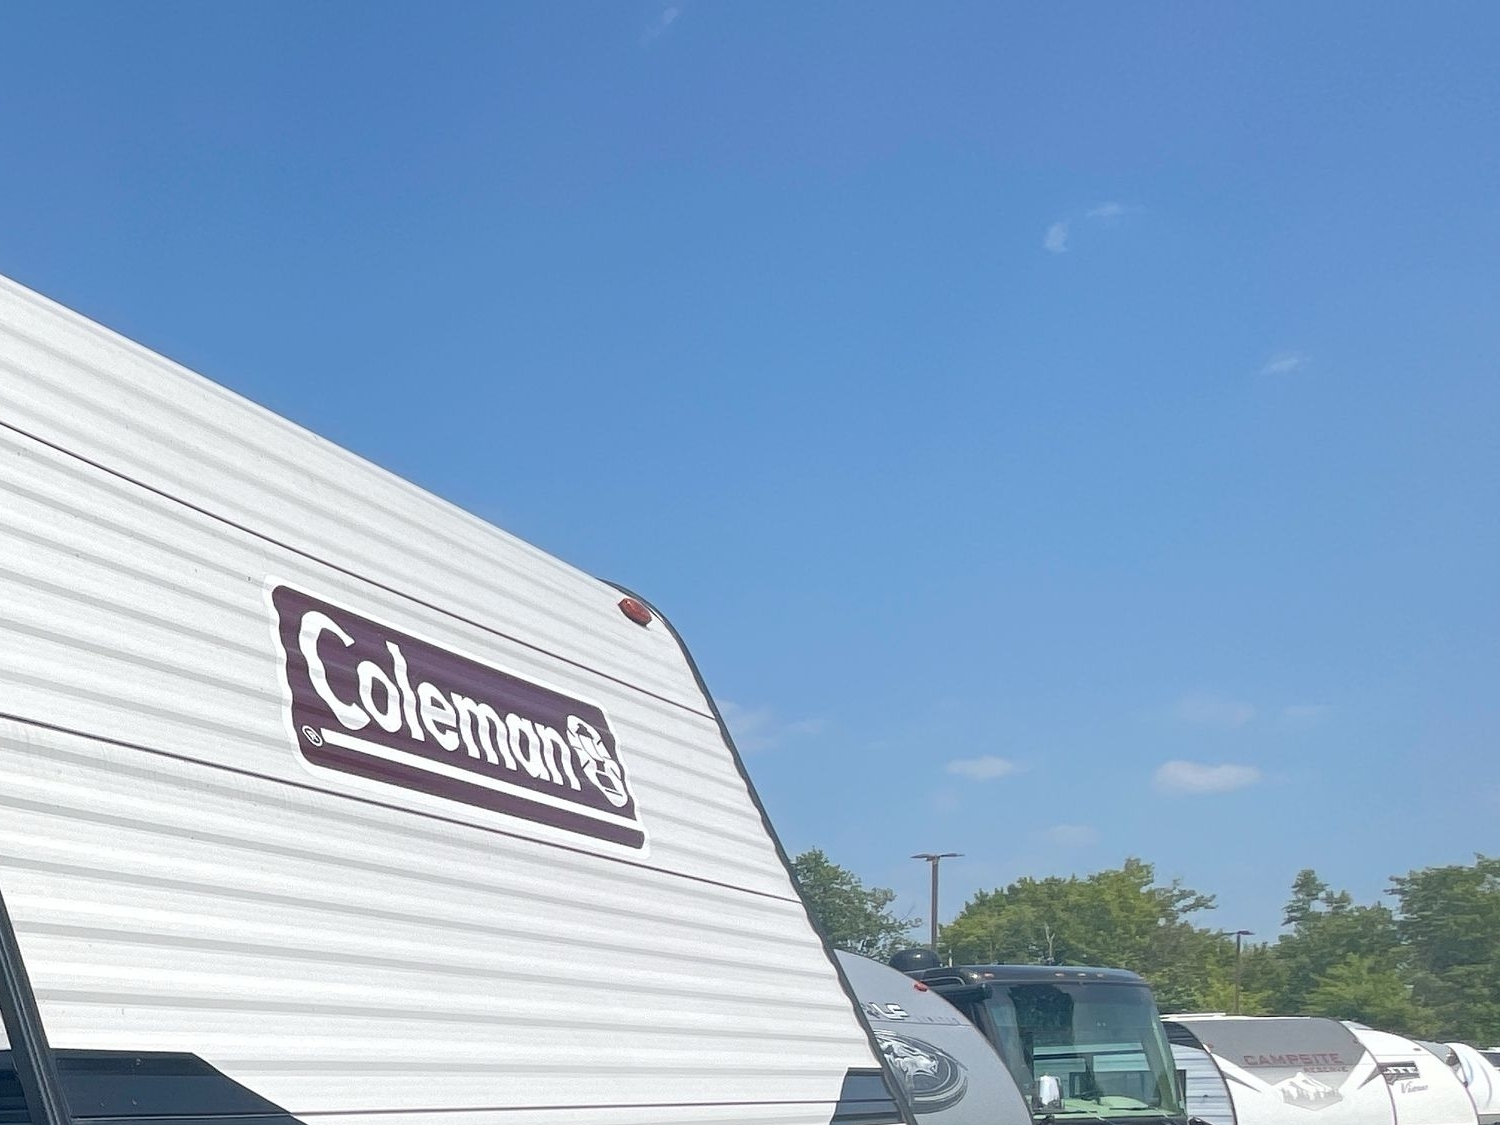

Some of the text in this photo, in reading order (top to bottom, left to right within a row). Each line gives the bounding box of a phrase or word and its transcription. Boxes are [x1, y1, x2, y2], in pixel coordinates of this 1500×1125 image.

[298, 610, 582, 791] Coleman
[1243, 1053, 1344, 1066] CAMPSITE
[1303, 1065, 1349, 1073] RESERVE
